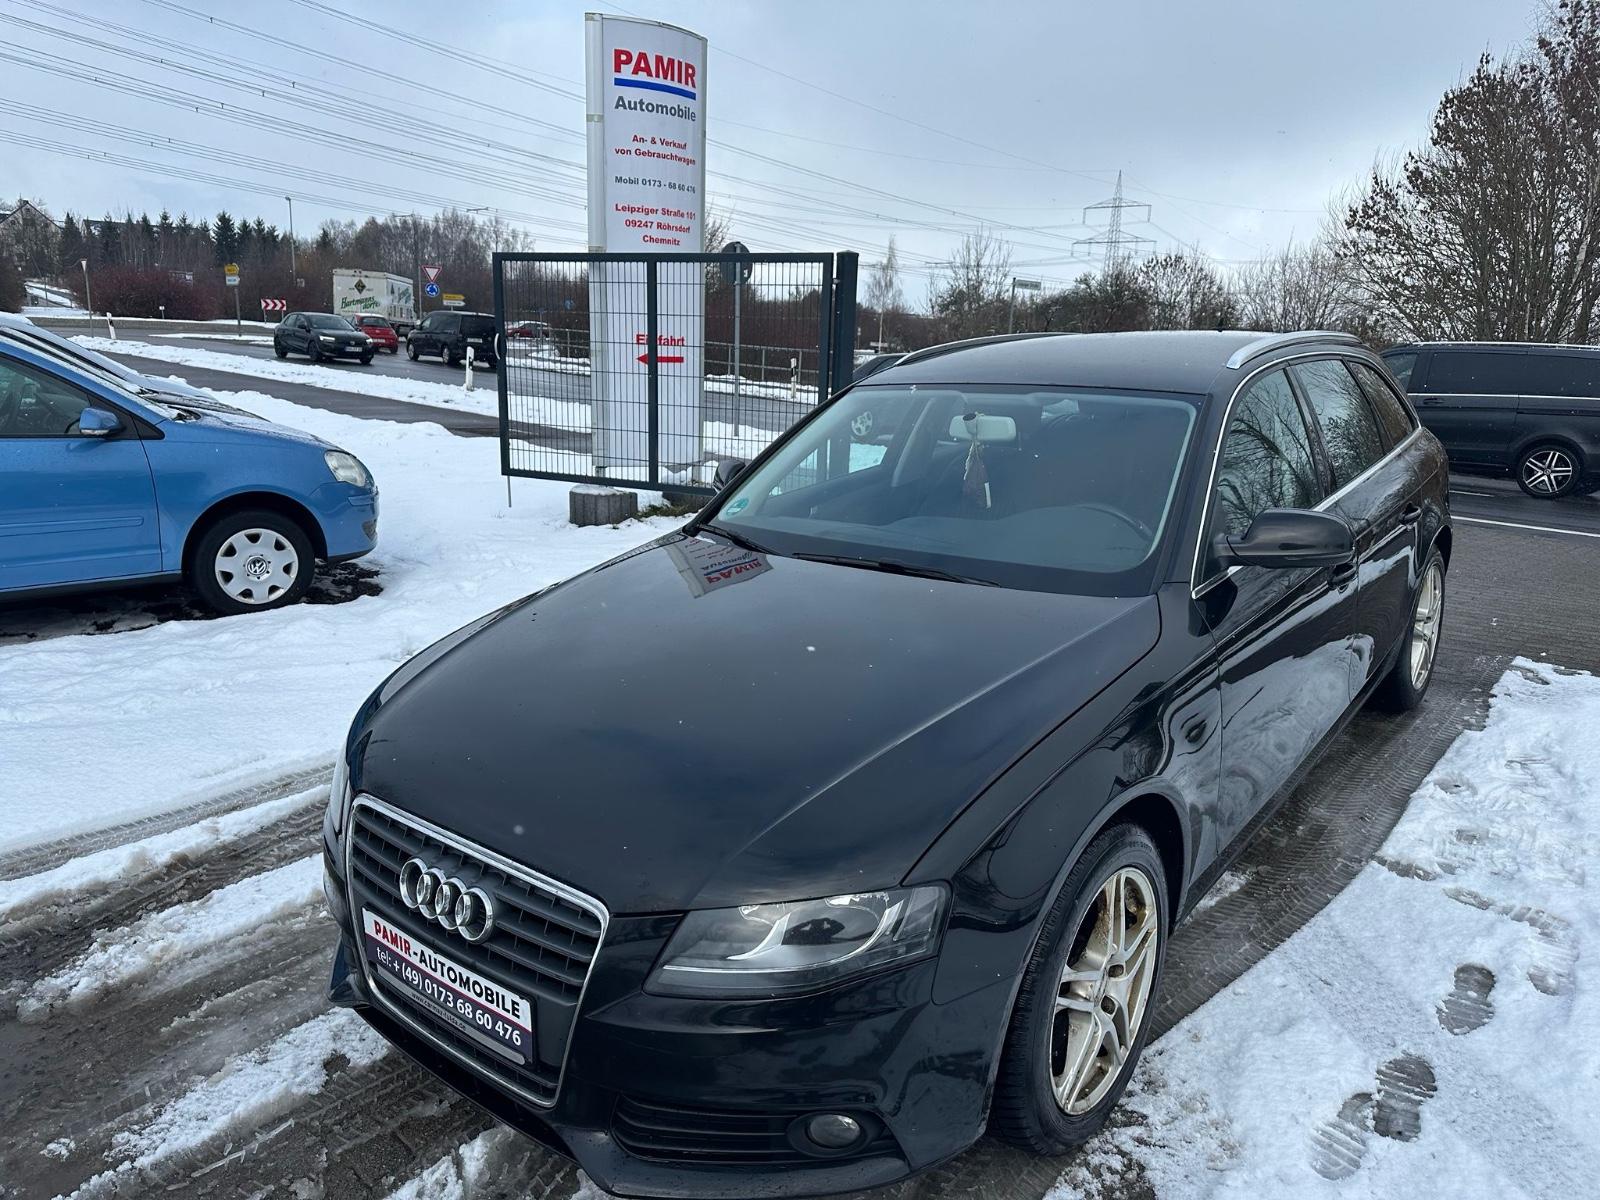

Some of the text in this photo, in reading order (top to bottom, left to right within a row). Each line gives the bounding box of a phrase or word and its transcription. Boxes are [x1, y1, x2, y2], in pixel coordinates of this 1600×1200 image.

[614, 48, 696, 89] PAMIR
[615, 95, 696, 121] Automobile
[632, 134, 687, 150] An- & Verkauf
[615, 147, 696, 166] von Gebrauchtwagen
[615, 175, 639, 185] Mobil
[641, 178, 662, 188] 0173
[668, 181, 677, 190] 68
[678, 183, 686, 192] 60
[615, 203, 696, 221] Leipziger Straße 101
[624, 218, 654, 229] 09247
[642, 234, 681, 246] Chemnitz
[376, 946, 392, 967] tel:
[424, 978, 454, 1008] 0173
[456, 998, 473, 1019] 68
[475, 1009, 492, 1030] 60
[494, 1020, 521, 1046] 476
